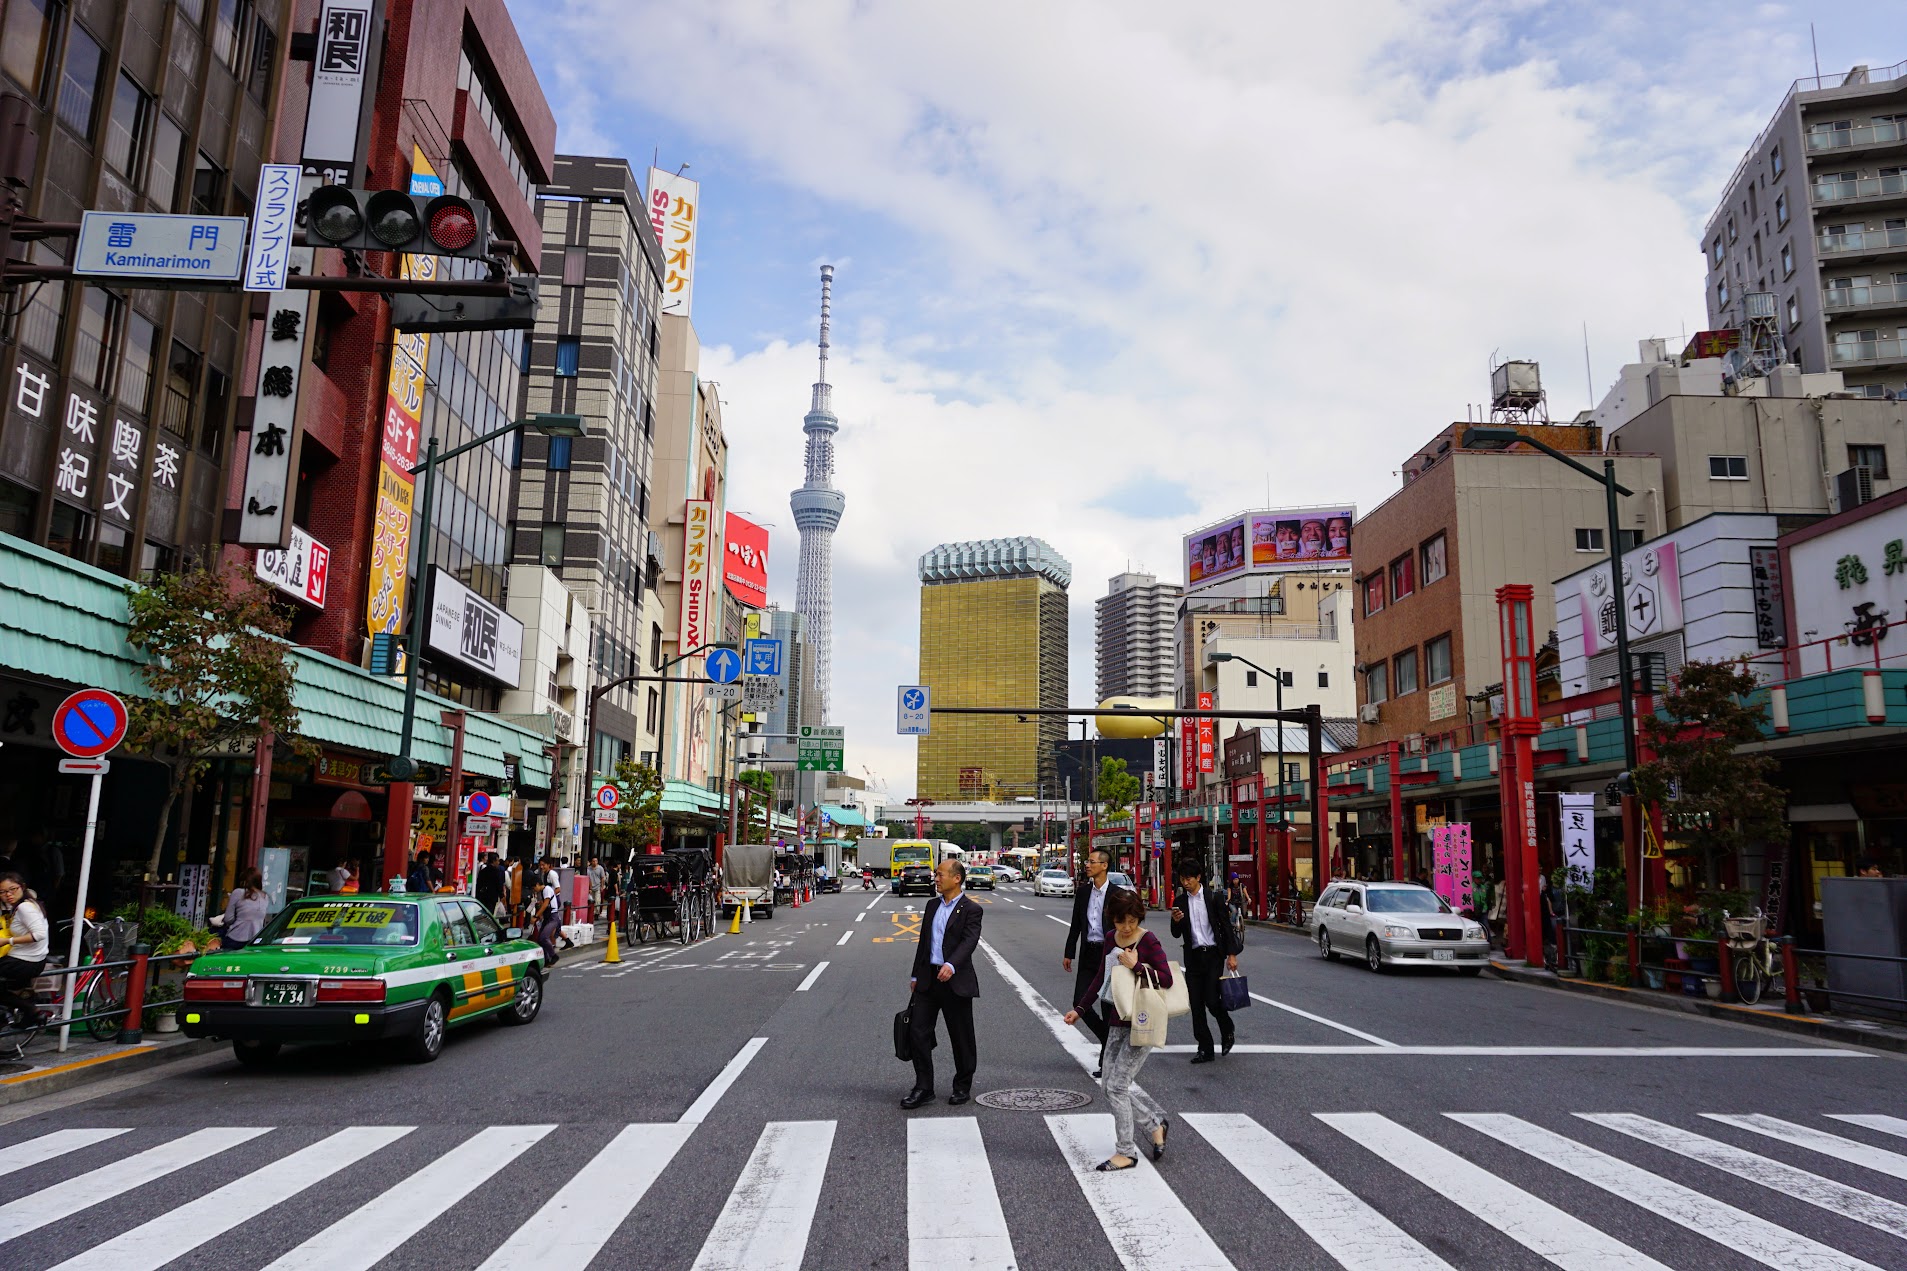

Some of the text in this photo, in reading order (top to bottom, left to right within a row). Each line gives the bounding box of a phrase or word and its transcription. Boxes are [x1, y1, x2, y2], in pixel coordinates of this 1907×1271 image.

[324, 12, 363, 70] 和民
[429, 182, 440, 195] OPEN
[108, 222, 218, 252] 雷門
[254, 170, 290, 286] スクランブル式
[666, 196, 694, 293] カラオケ
[105, 252, 211, 271] Kaminarimon
[387, 407, 405, 443] 5F
[374, 495, 389, 569] パスタ
[395, 510, 409, 579] ワイン
[687, 506, 707, 575] カラオケ
[312, 548, 326, 573] 1F
[1297, 581, 1343, 591] 中山ビル
[435, 613, 452, 630] DINING
[437, 602, 460, 623] JAPANESE
[687, 579, 701, 648] SHIDAX
[463, 602, 498, 666] 和民
[708, 687, 735, 697] 8-20
[813, 728, 842, 736] 首都高速
[286, 983, 298, 991] 500
